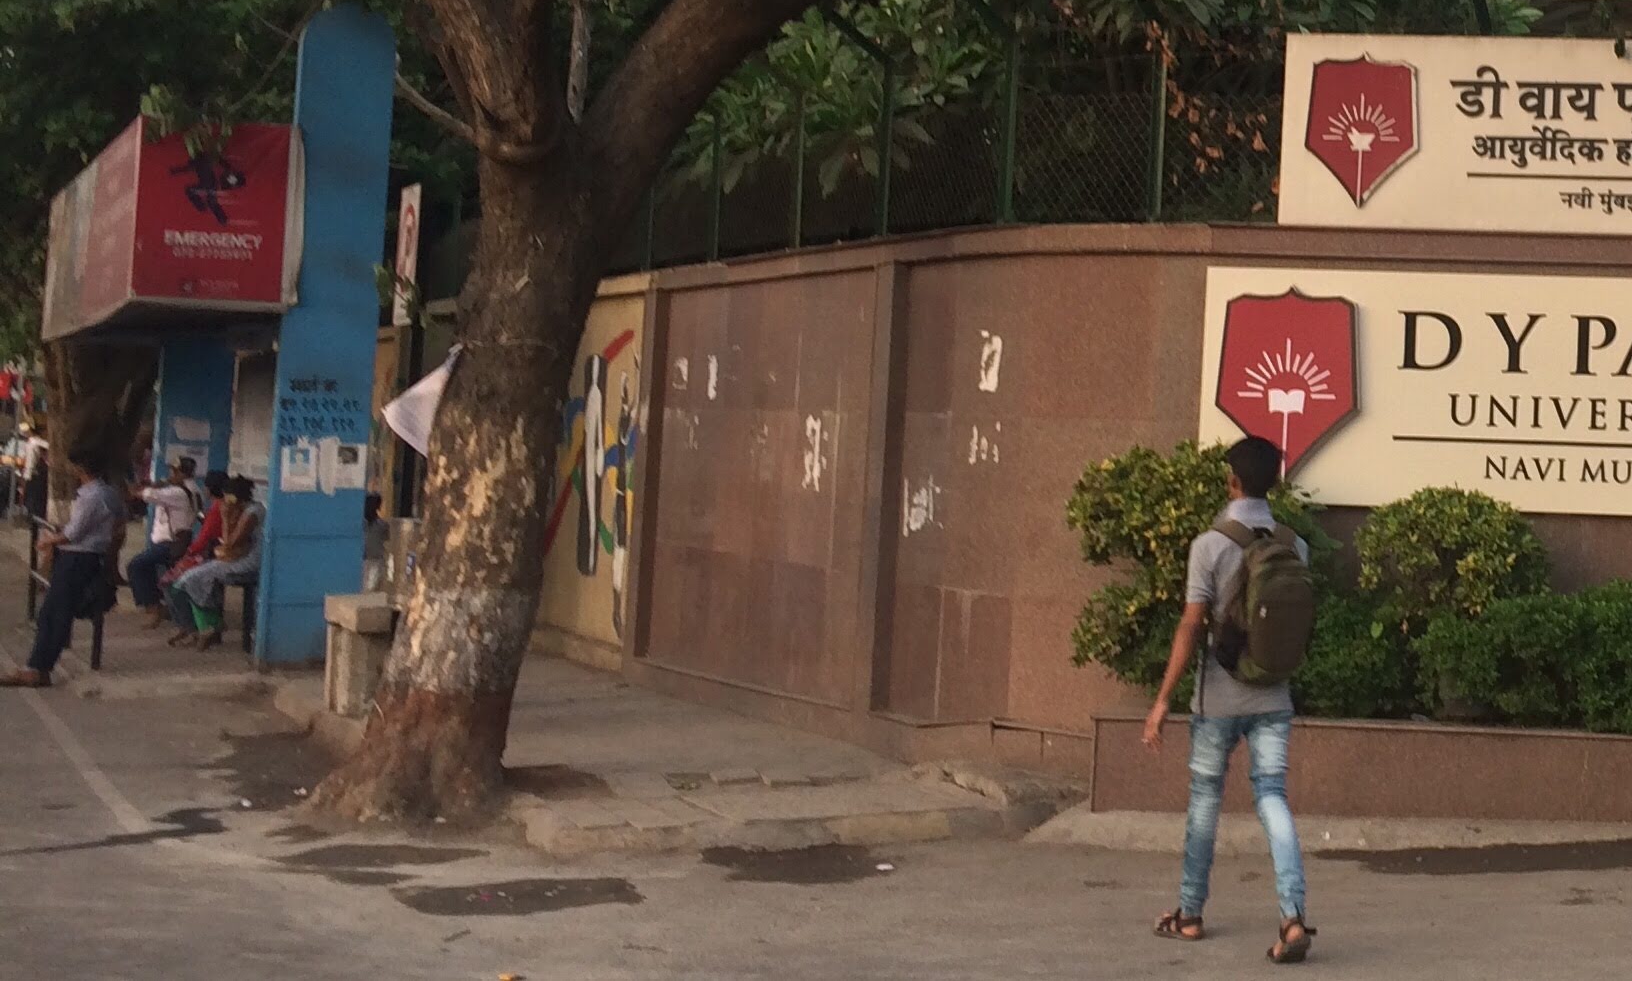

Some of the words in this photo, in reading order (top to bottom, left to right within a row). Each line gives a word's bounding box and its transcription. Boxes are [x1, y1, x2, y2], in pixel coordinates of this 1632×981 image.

[1450, 65, 1508, 119] डी
[1516, 80, 1603, 120] वाय
[1472, 126, 1608, 167] आयुर्वेदिक
[1559, 187, 1594, 209] नवी
[164, 229, 263, 250] EMERGENCY
[1398, 309, 1463, 371] D
[1485, 312, 1546, 375] Y
[1484, 455, 1566, 483] NAVI
